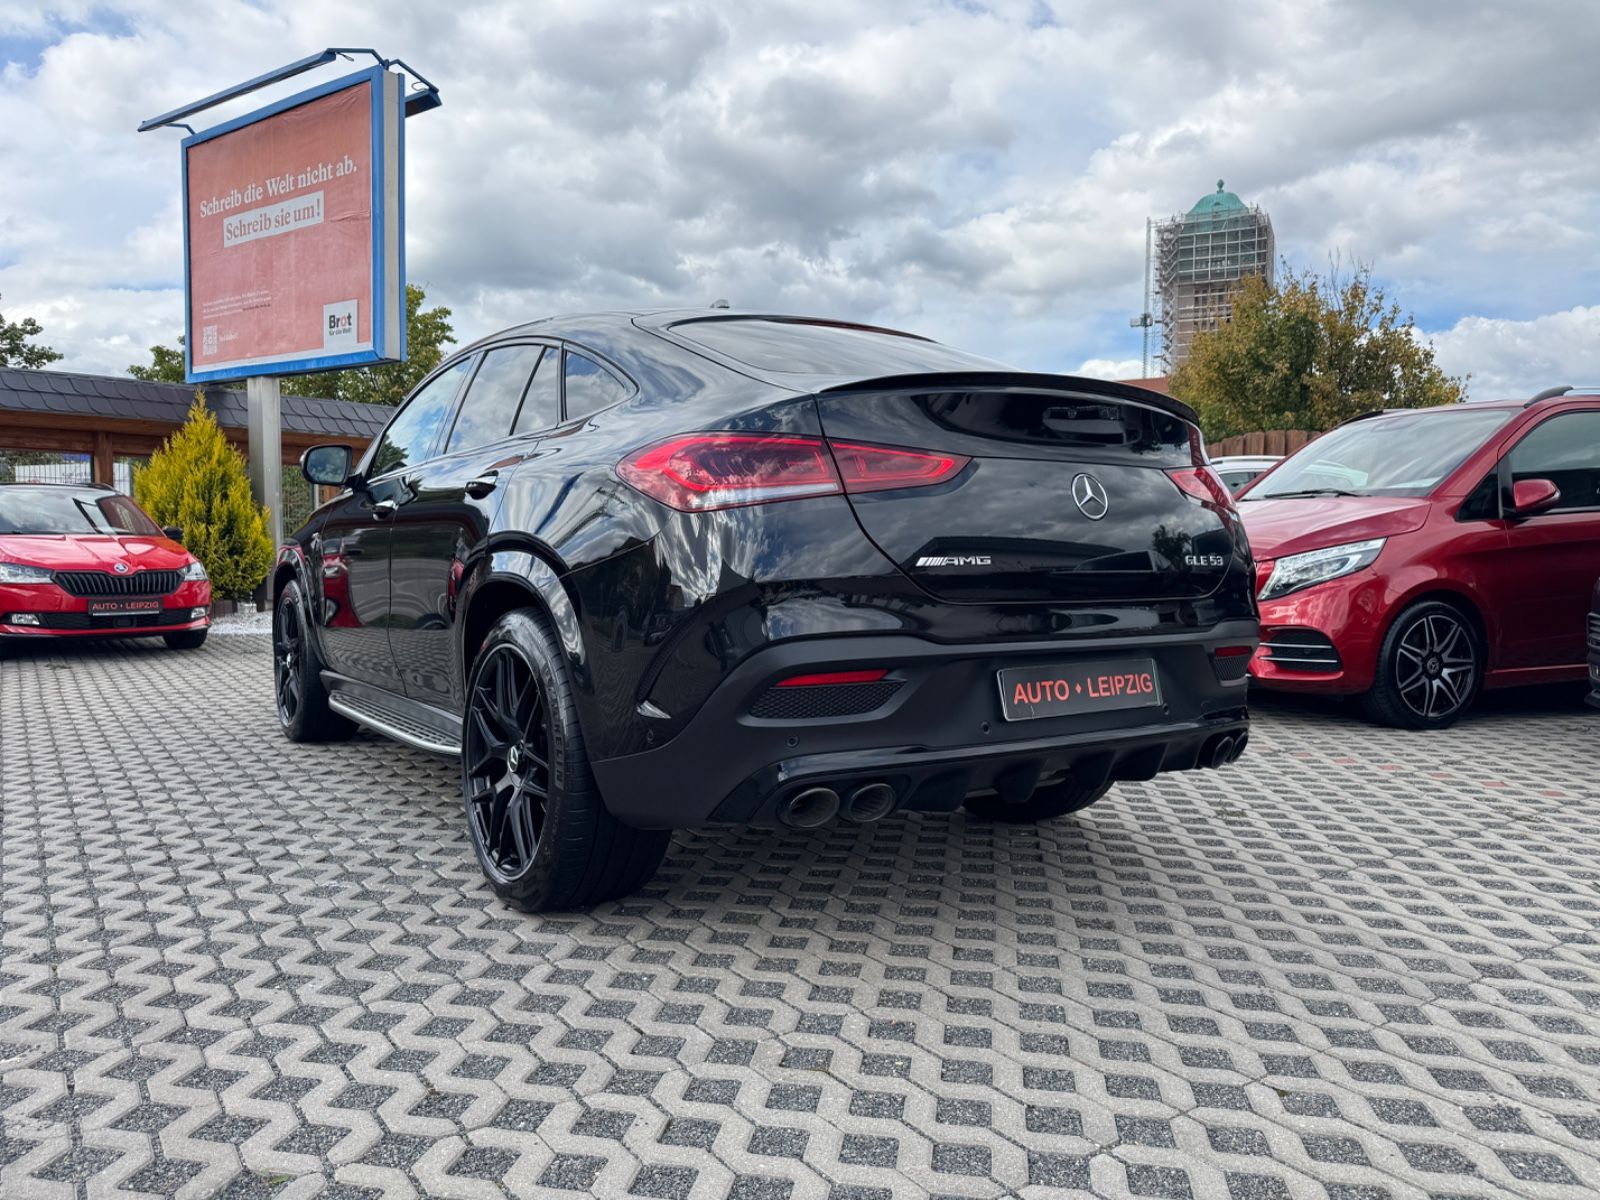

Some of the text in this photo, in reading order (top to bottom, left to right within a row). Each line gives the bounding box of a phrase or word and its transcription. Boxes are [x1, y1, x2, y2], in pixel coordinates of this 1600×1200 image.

[200, 155, 358, 218] Schreib die Welt nicht ab.
[225, 198, 321, 241] Schreib sie um!
[328, 312, 352, 329] Brot
[941, 556, 992, 567] AMG
[1184, 554, 1224, 567] GLE 53
[93, 601, 159, 610] AUTO LEIPZIG
[1013, 672, 1153, 705] AUTO LEIPZIG
